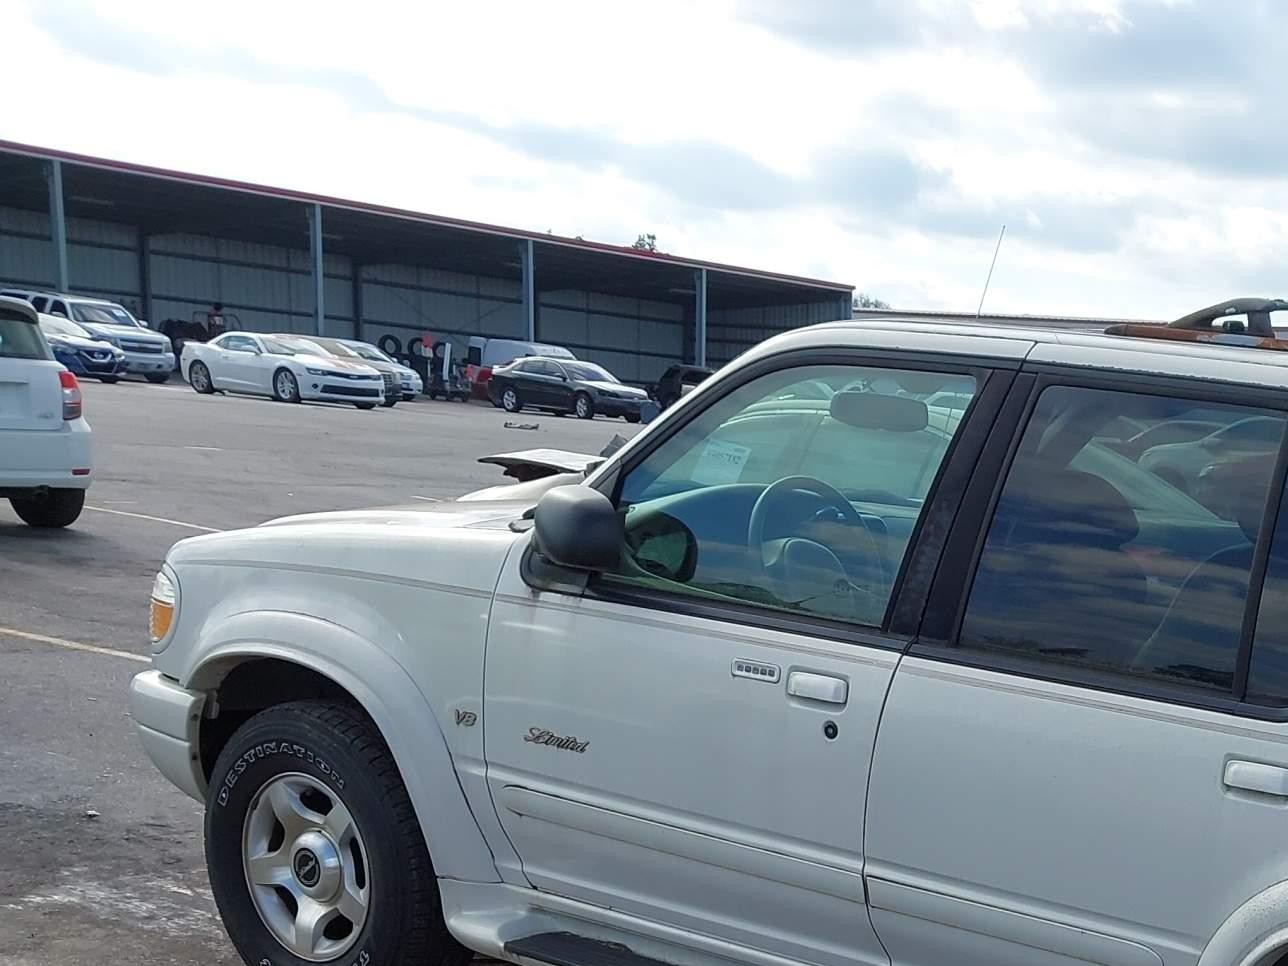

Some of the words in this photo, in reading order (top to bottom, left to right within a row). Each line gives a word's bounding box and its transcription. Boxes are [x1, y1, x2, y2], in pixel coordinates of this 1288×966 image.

[454, 709, 478, 727] V8
[523, 726, 591, 754] Limited
[217, 741, 345, 808] DESTINATION
